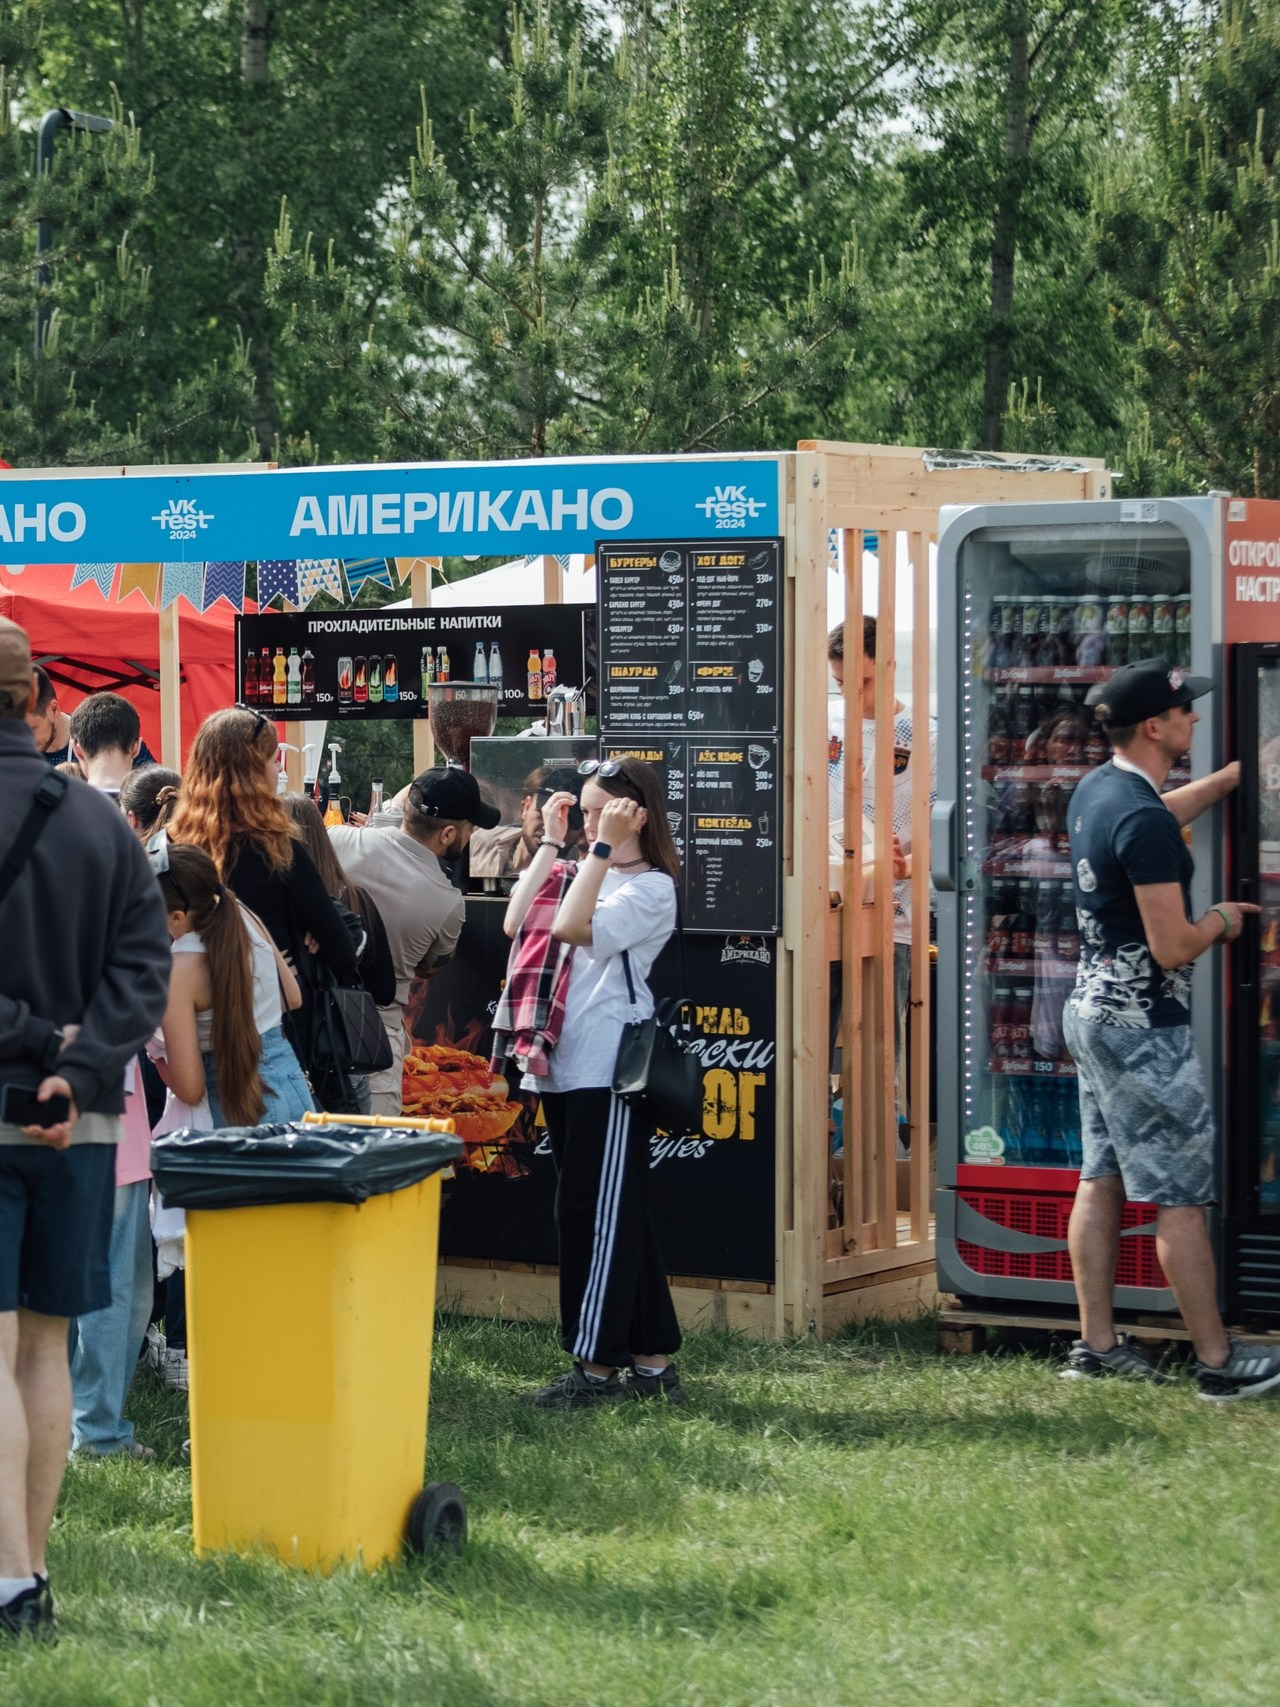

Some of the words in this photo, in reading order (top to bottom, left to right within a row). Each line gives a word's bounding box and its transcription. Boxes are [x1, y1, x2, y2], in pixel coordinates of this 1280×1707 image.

[714, 485, 747, 501] VK
[169, 499, 197, 514] VK
[289, 487, 634, 537] АМЕРИКАНО
[695, 496, 766, 518] fest
[151, 510, 214, 529] fest
[715, 519, 745, 529] 2024
[169, 531, 196, 540] 2024
[696, 556, 716, 566] ХОТ
[308, 618, 436, 634] ПРОХЛАДИТЕЛЬНЫЕ
[440, 616, 502, 629] НАПИТКИ
[697, 666, 734, 677] ФРИ
[718, 752, 744, 762] КОФЕ
[721, 949, 771, 964] АМЕРИКАНО
[1034, 1062, 1053, 1071] 150
[1059, 1064, 1078, 1073] Добр
